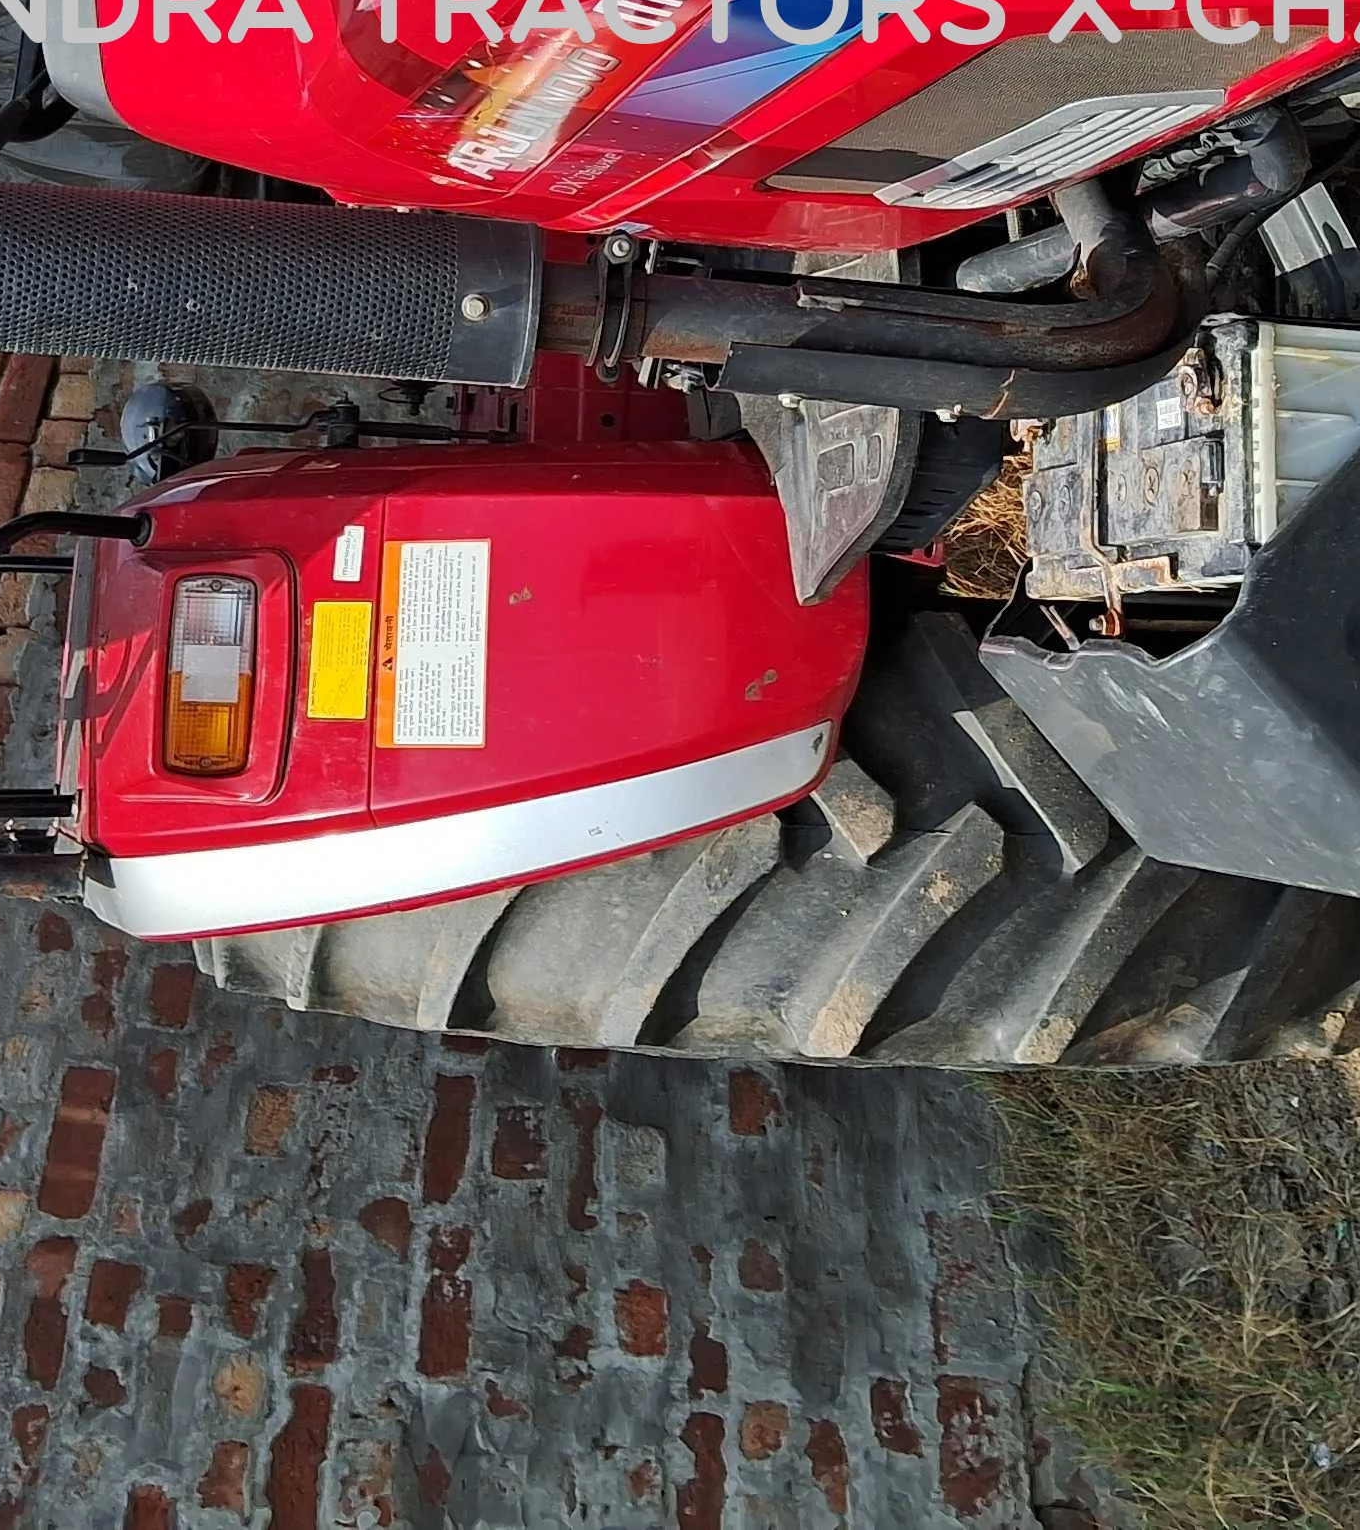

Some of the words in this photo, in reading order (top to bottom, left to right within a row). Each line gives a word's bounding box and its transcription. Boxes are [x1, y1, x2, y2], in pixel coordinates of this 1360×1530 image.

[446, 102, 558, 182] ARJUN
[538, 47, 621, 106] NOVO
[548, 177, 587, 196] DX
